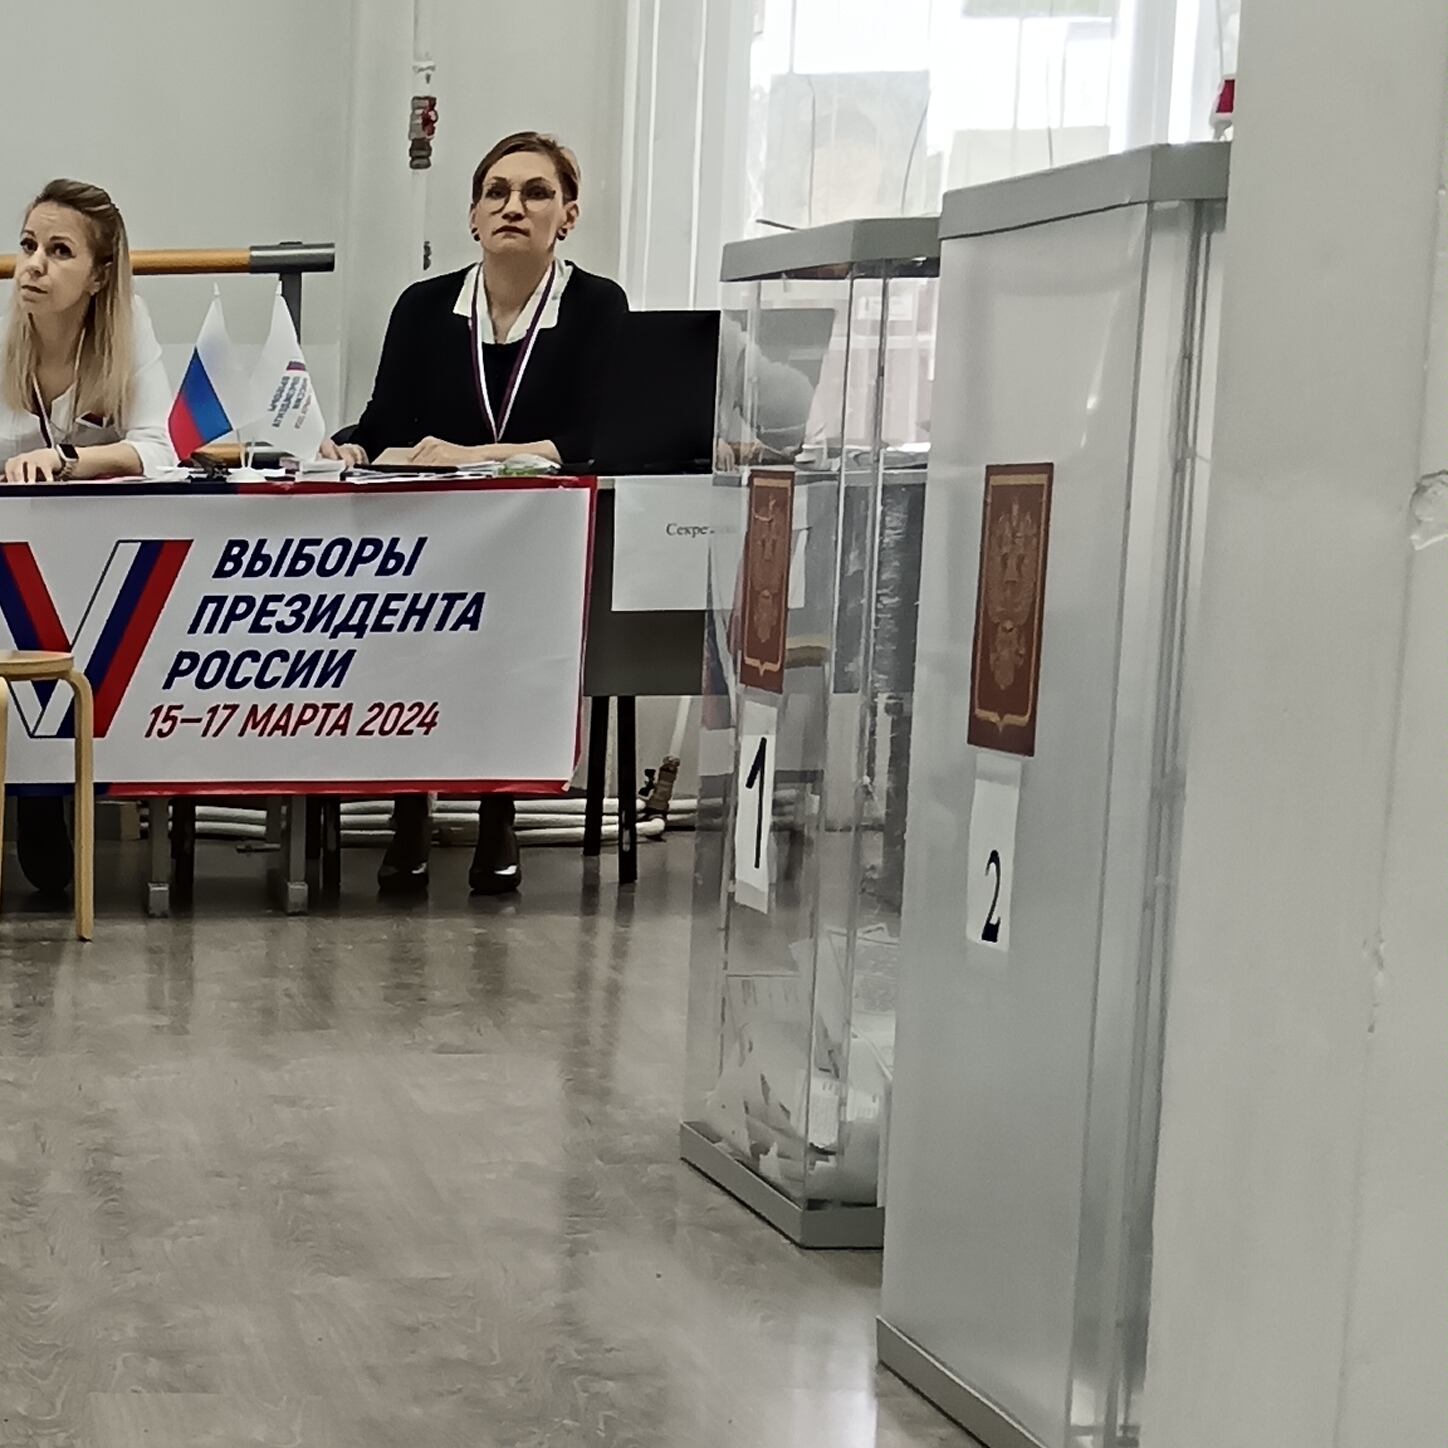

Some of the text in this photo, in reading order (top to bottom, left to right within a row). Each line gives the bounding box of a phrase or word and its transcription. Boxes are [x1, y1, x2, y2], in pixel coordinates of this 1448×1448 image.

[212, 537, 428, 578] ВЫБОРЫ
[187, 591, 486, 640] ПРЕЗИДЕНТА
[162, 649, 357, 690] РОССИИ
[238, 702, 353, 737] МАРТА
[356, 702, 439, 737] 2024
[745, 737, 767, 869] 1
[981, 849, 1001, 943] 2
